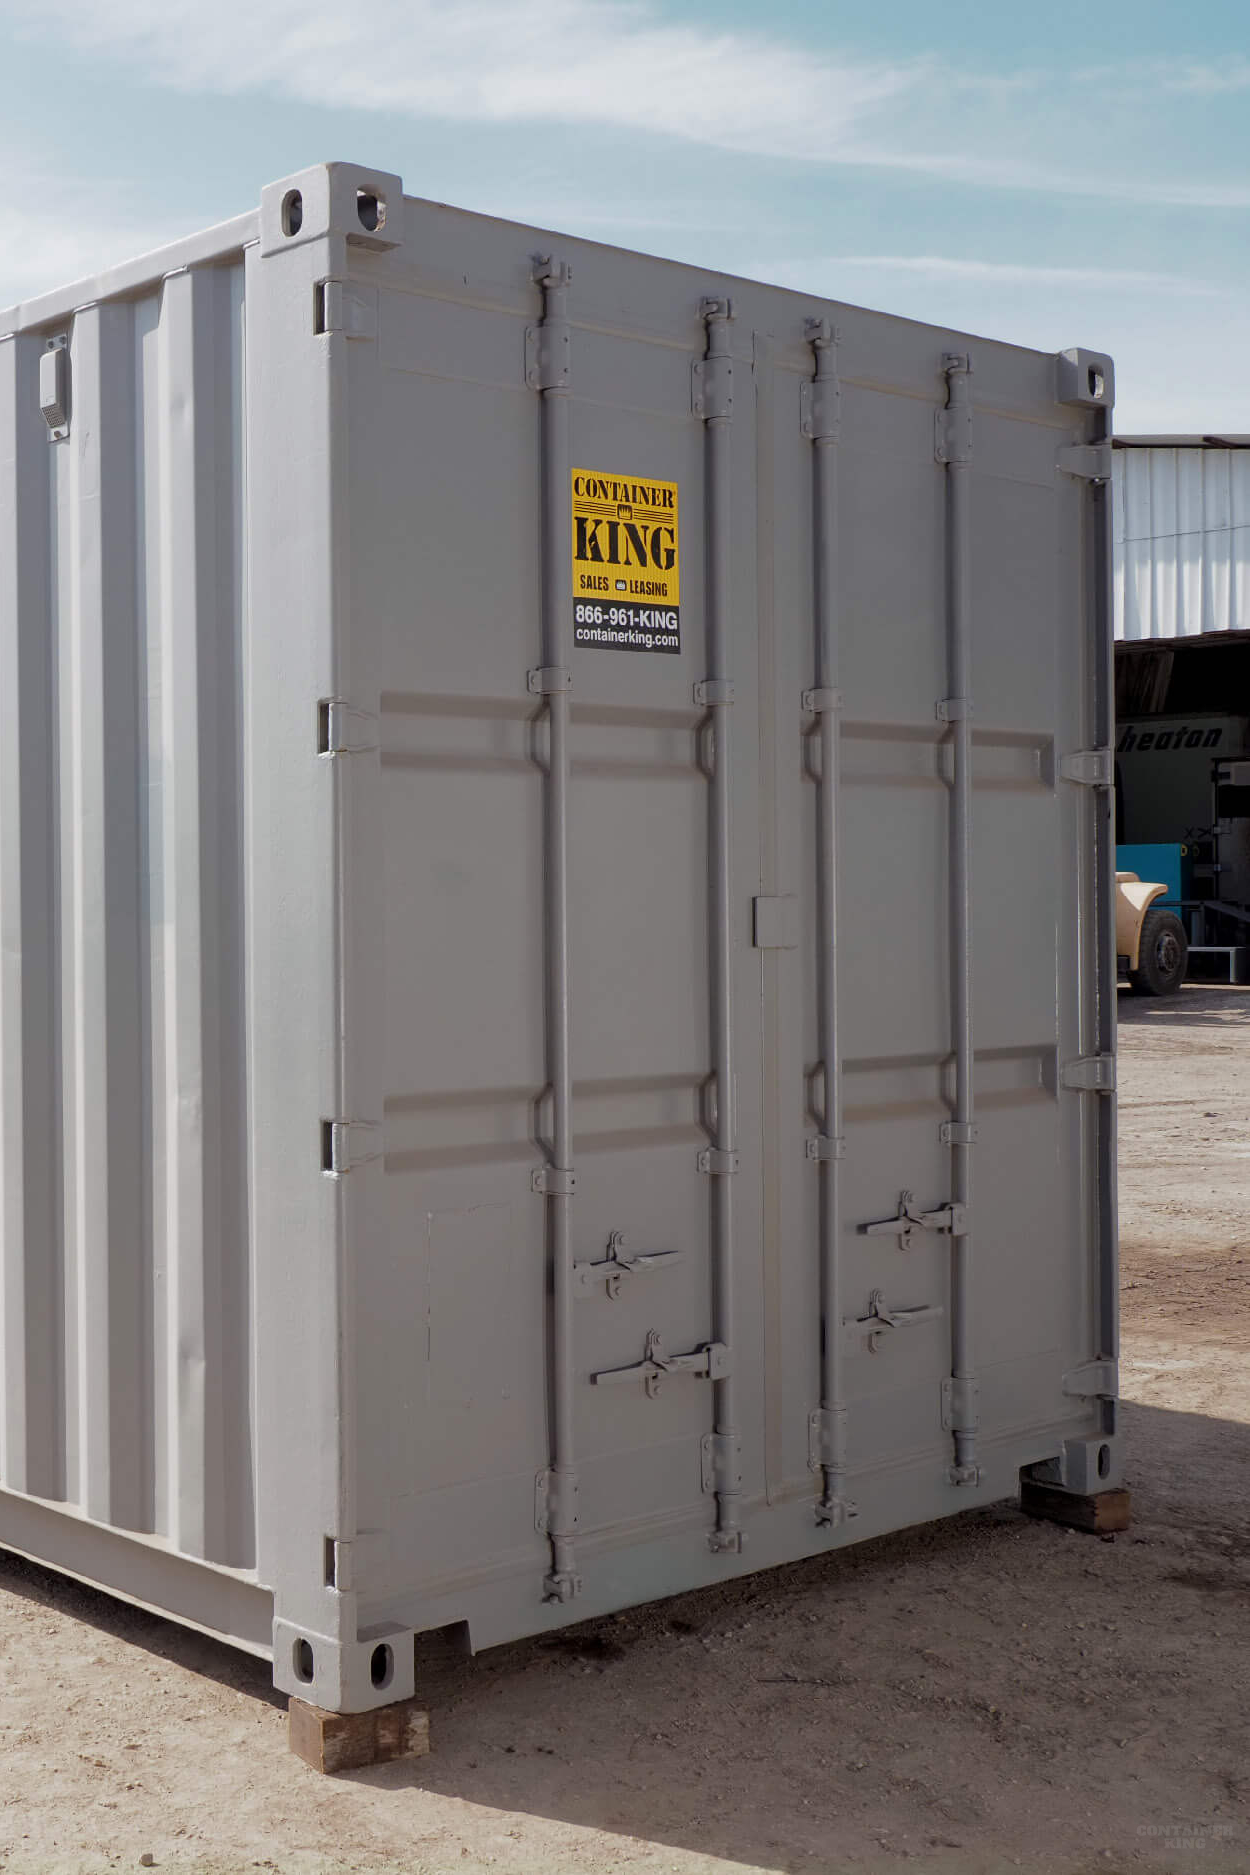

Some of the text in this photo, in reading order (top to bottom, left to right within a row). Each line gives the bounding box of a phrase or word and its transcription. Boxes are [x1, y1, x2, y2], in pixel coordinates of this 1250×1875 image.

[574, 476, 674, 508] CONTAINER
[574, 516, 676, 570] KING
[580, 574, 668, 597] SALES LEASING
[575, 604, 678, 629] 866-961-KING
[576, 627, 679, 647] containerking.com
